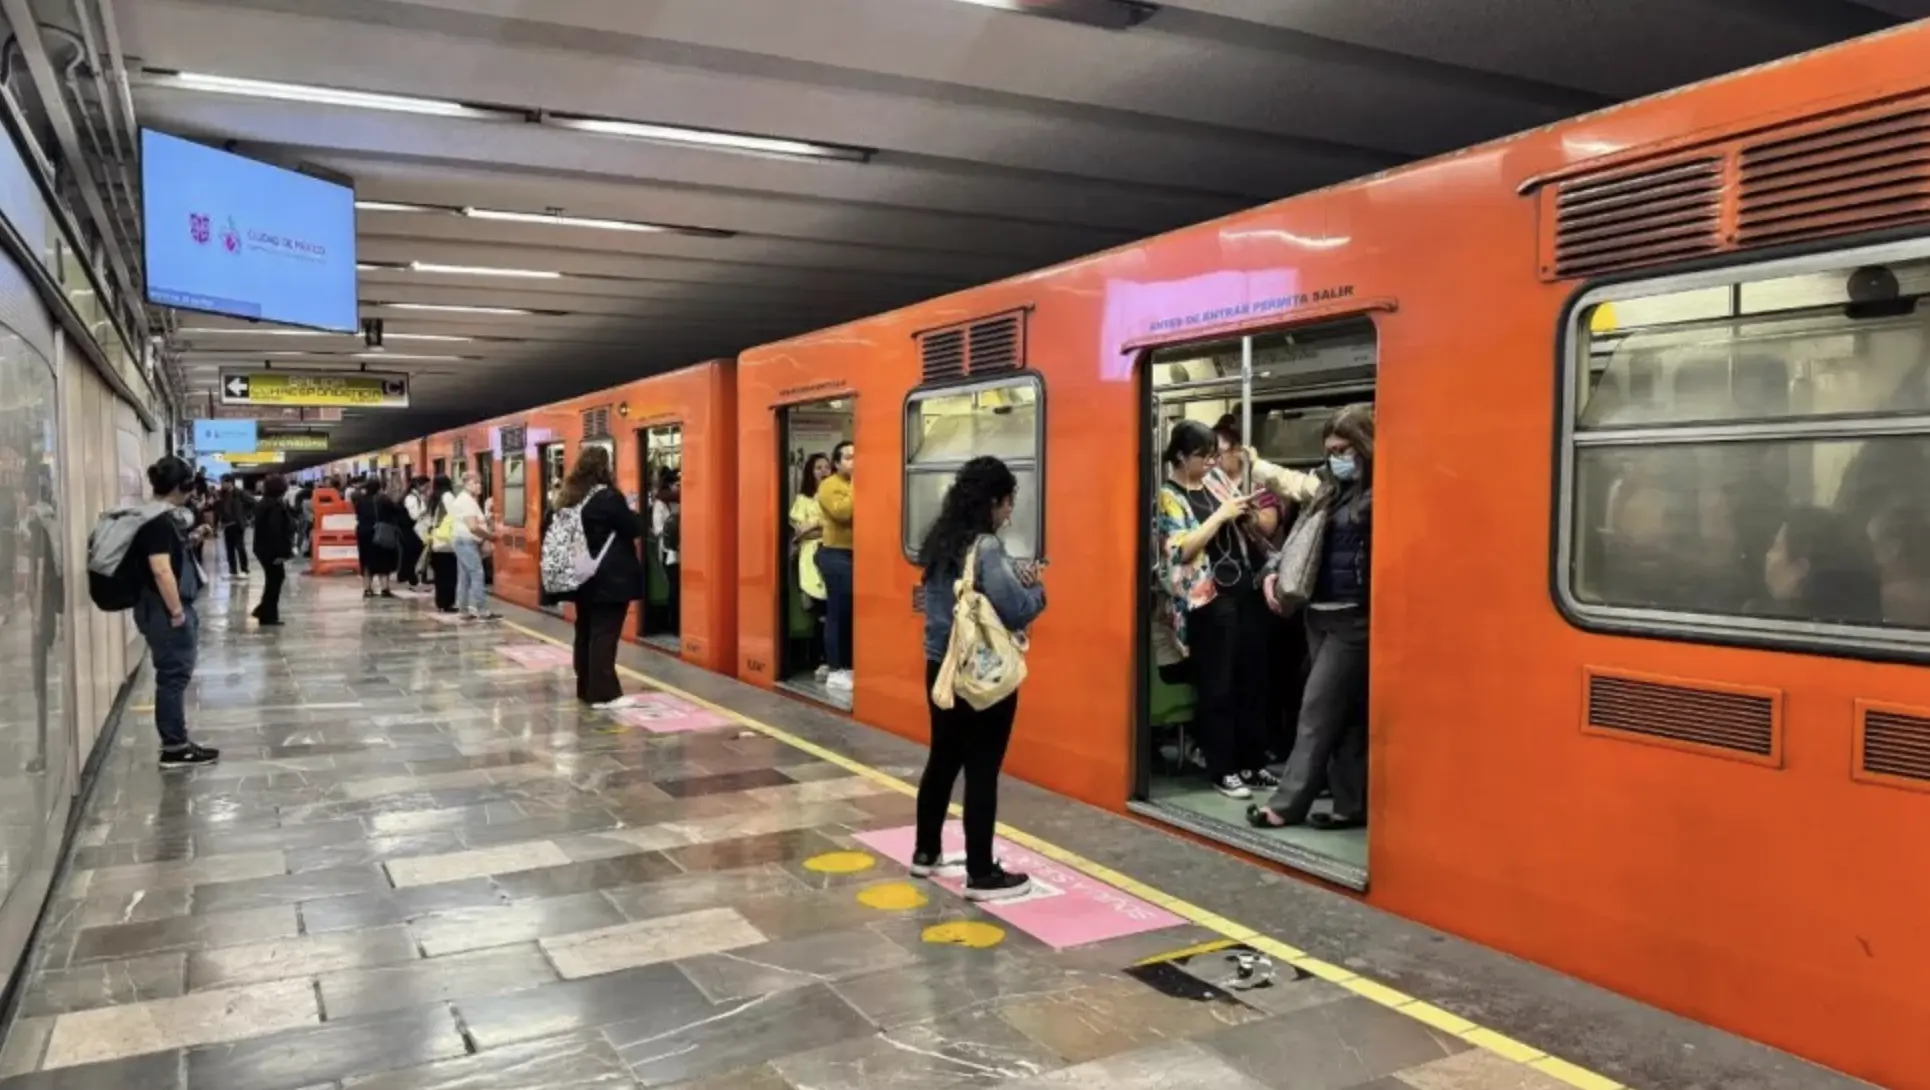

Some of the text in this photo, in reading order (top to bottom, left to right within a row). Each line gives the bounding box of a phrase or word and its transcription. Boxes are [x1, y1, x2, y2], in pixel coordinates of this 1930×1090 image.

[1150, 285, 1354, 331] ANTES DE ENTRAR PERMITA SALIR
